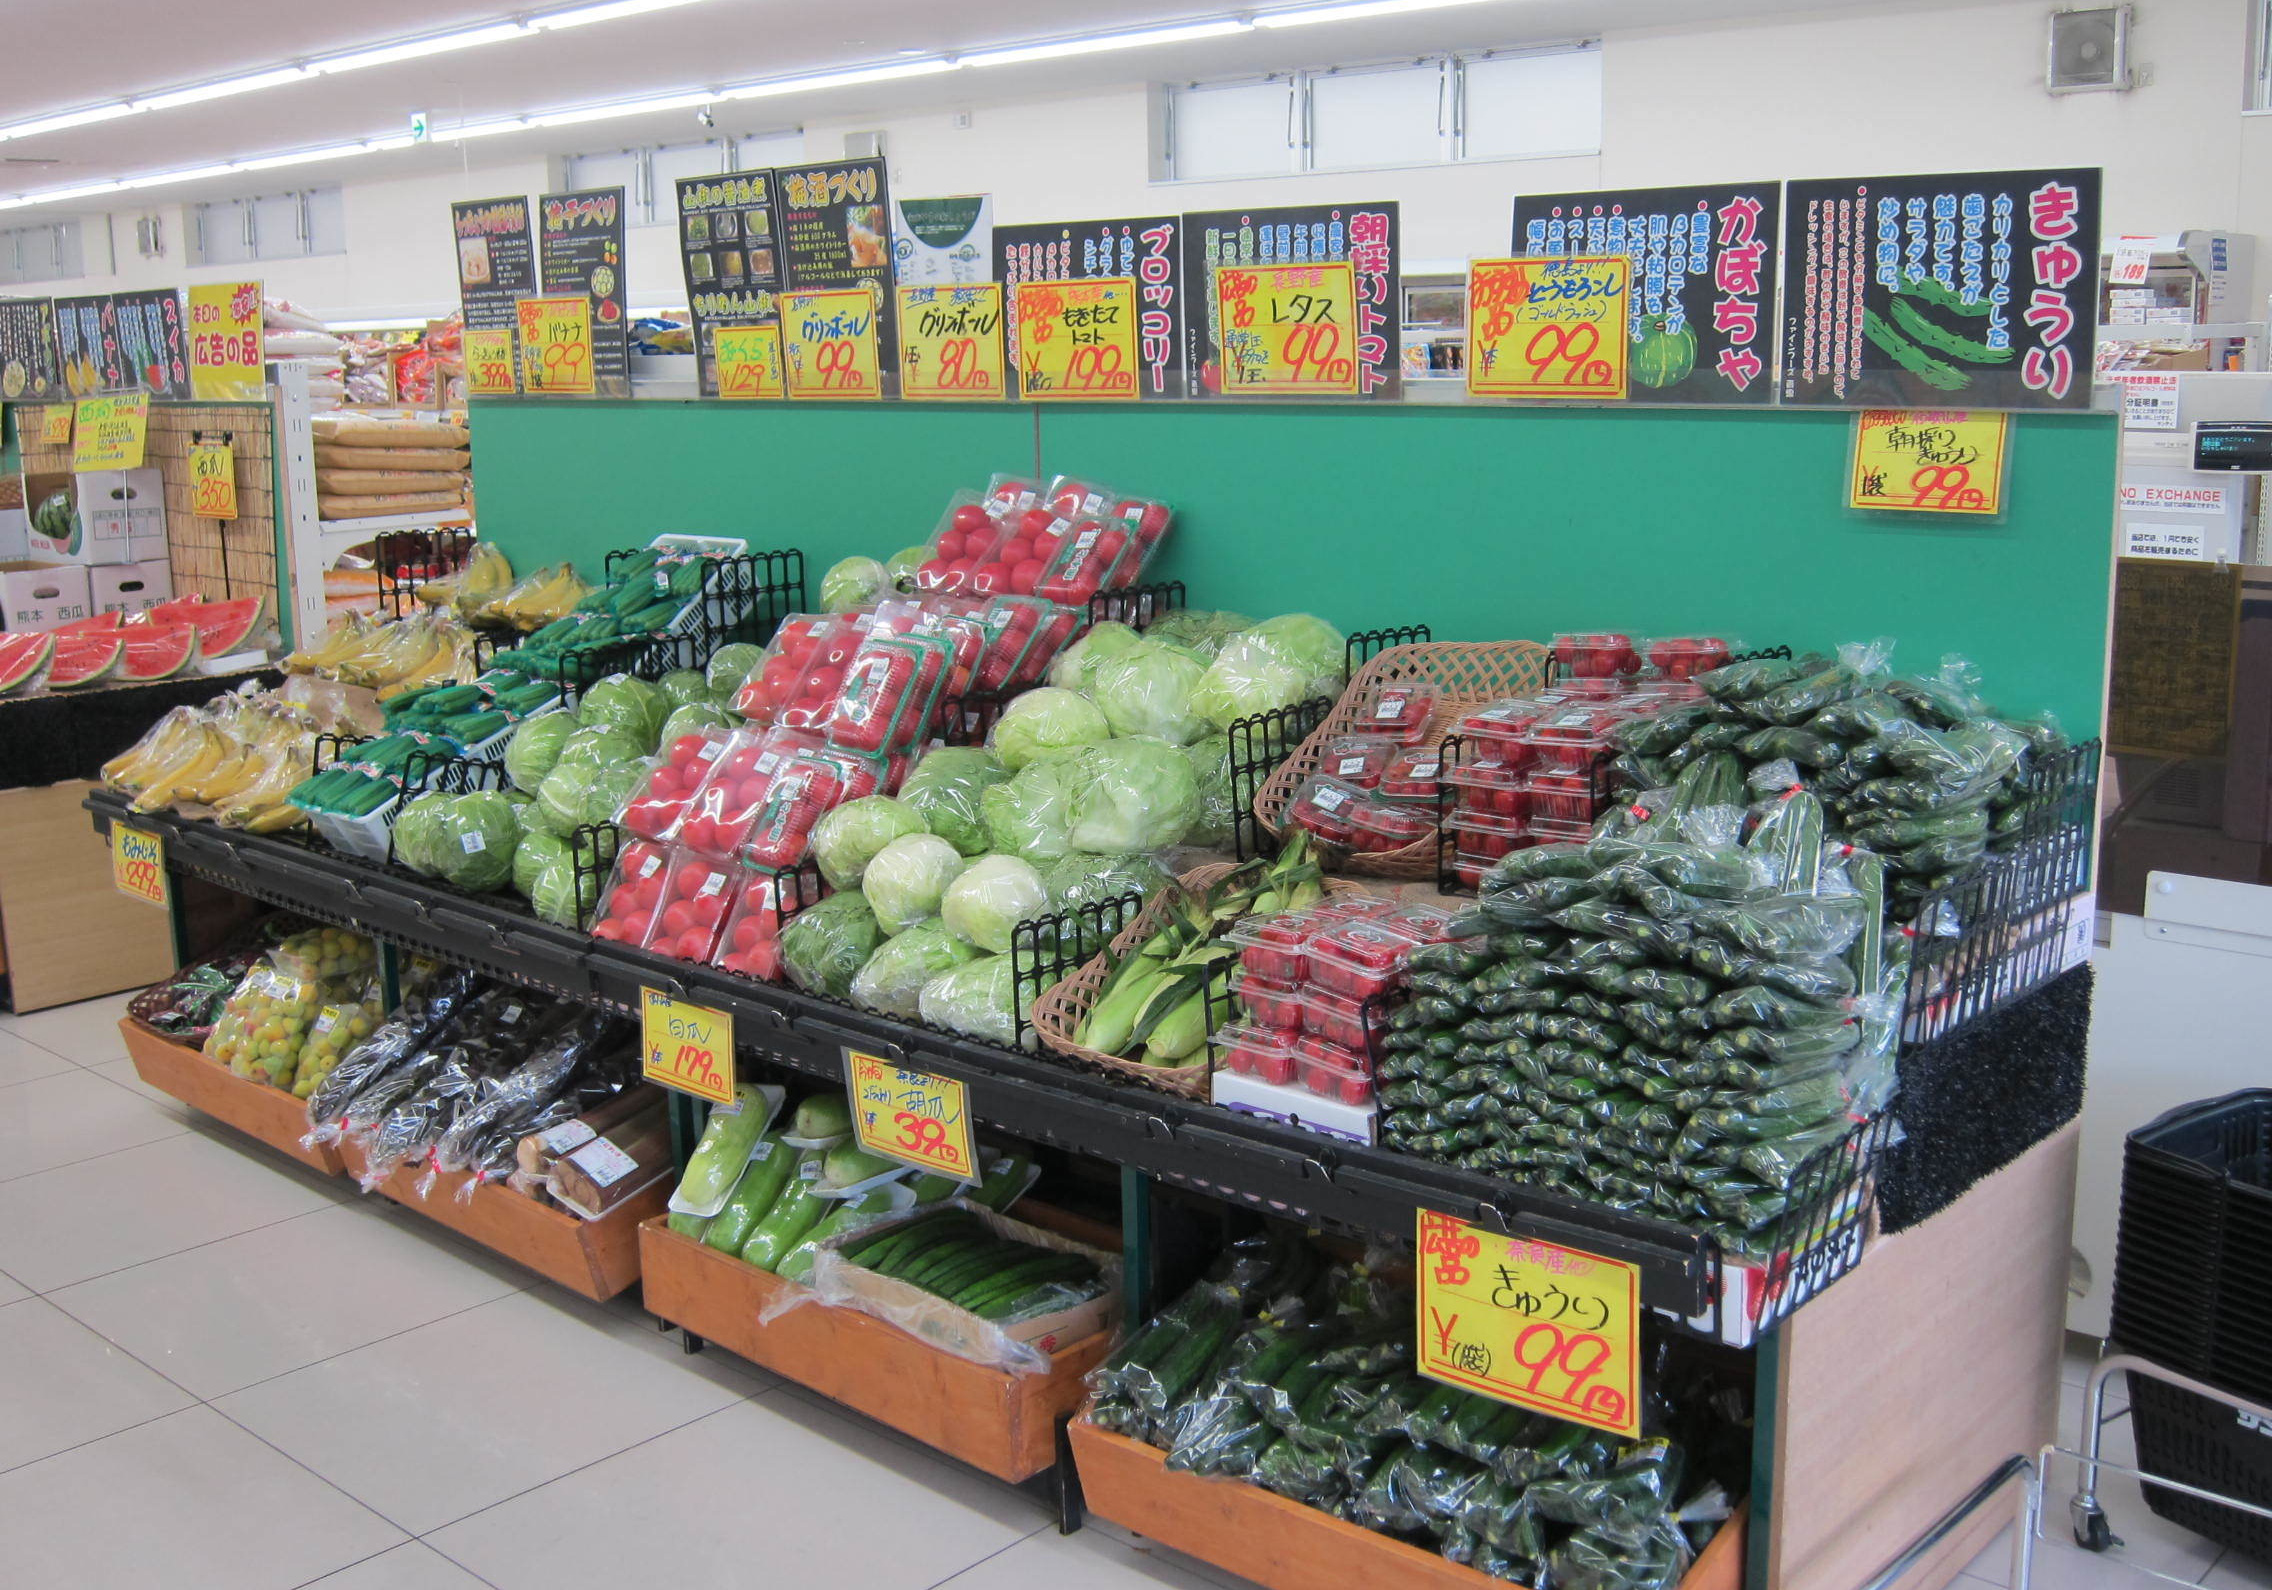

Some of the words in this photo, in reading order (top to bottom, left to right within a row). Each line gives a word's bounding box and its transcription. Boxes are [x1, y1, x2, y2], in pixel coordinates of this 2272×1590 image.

[787, 166, 878, 210] 梅酒づくり
[1645, 214, 1669, 316] 肌や粘膜を
[1689, 212, 1711, 275] 豊富な
[1875, 195, 1902, 295] 炒め物に。
[1905, 196, 1929, 285] サラダや
[1932, 193, 1958, 294] 魅力です。
[1959, 192, 1986, 307] 歯ごたえが
[1985, 192, 2014, 351] カリカリとした
[919, 302, 1000, 338] グリンボール
[1139, 223, 1173, 393] ブロッコリー
[1271, 293, 1336, 325] レタス
[1348, 211, 1391, 395] 朝採りトマト
[1527, 273, 1625, 304] とうもろこし
[1712, 194, 1768, 393] かぼちゃ
[2020, 180, 2083, 400] きゅうり
[163, 297, 185, 384] スイカ
[194, 330, 259, 367] 広告の品
[544, 342, 586, 388] 99
[549, 322, 583, 343] バナナ
[1071, 328, 1105, 346] トマト
[1786, 317, 1798, 377] ファインフーズ
[2120, 487, 2138, 499] NO
[2145, 488, 2222, 502] EXCHANGE
[17, 610, 44, 624] 熊本
[57, 604, 85, 620] 西瓜
[1491, 1263, 1610, 1330] きゅうり
